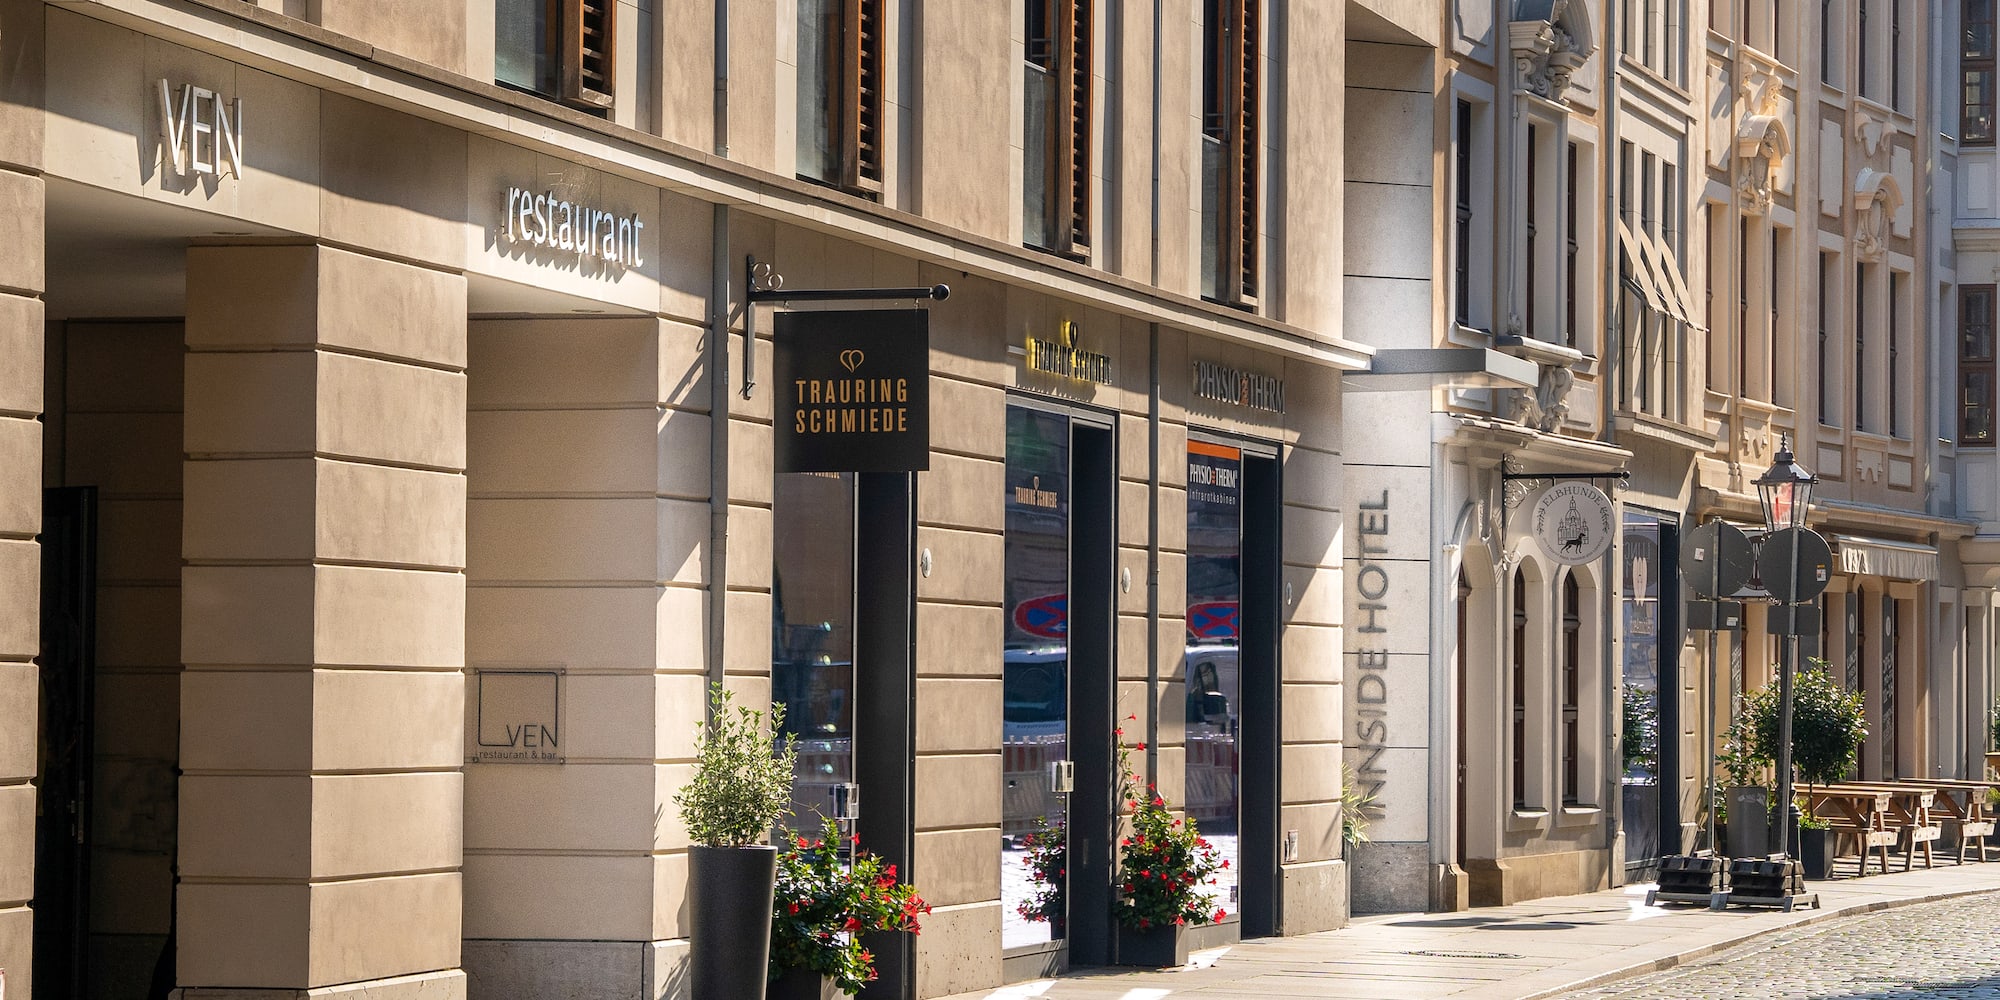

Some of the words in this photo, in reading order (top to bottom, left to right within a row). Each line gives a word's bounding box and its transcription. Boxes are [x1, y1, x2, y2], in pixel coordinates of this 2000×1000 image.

[163, 78, 242, 180] VEN
[508, 186, 644, 267] restaurant
[795, 378, 908, 404] TRAURING
[1199, 361, 1241, 405] PHYSIO
[1249, 373, 1286, 415] THERM
[795, 407, 908, 434] SCHMIEDE
[1189, 463, 1212, 485] PHYSIO
[1542, 486, 1603, 507] ELBHUNDE
[1357, 489, 1388, 633] HOTEL
[506, 724, 558, 747] VEN
[1357, 648, 1388, 820] INNSIDE
[479, 750, 528, 760] restaurant
[531, 750, 538, 760] &
[541, 750, 557, 760] bar
